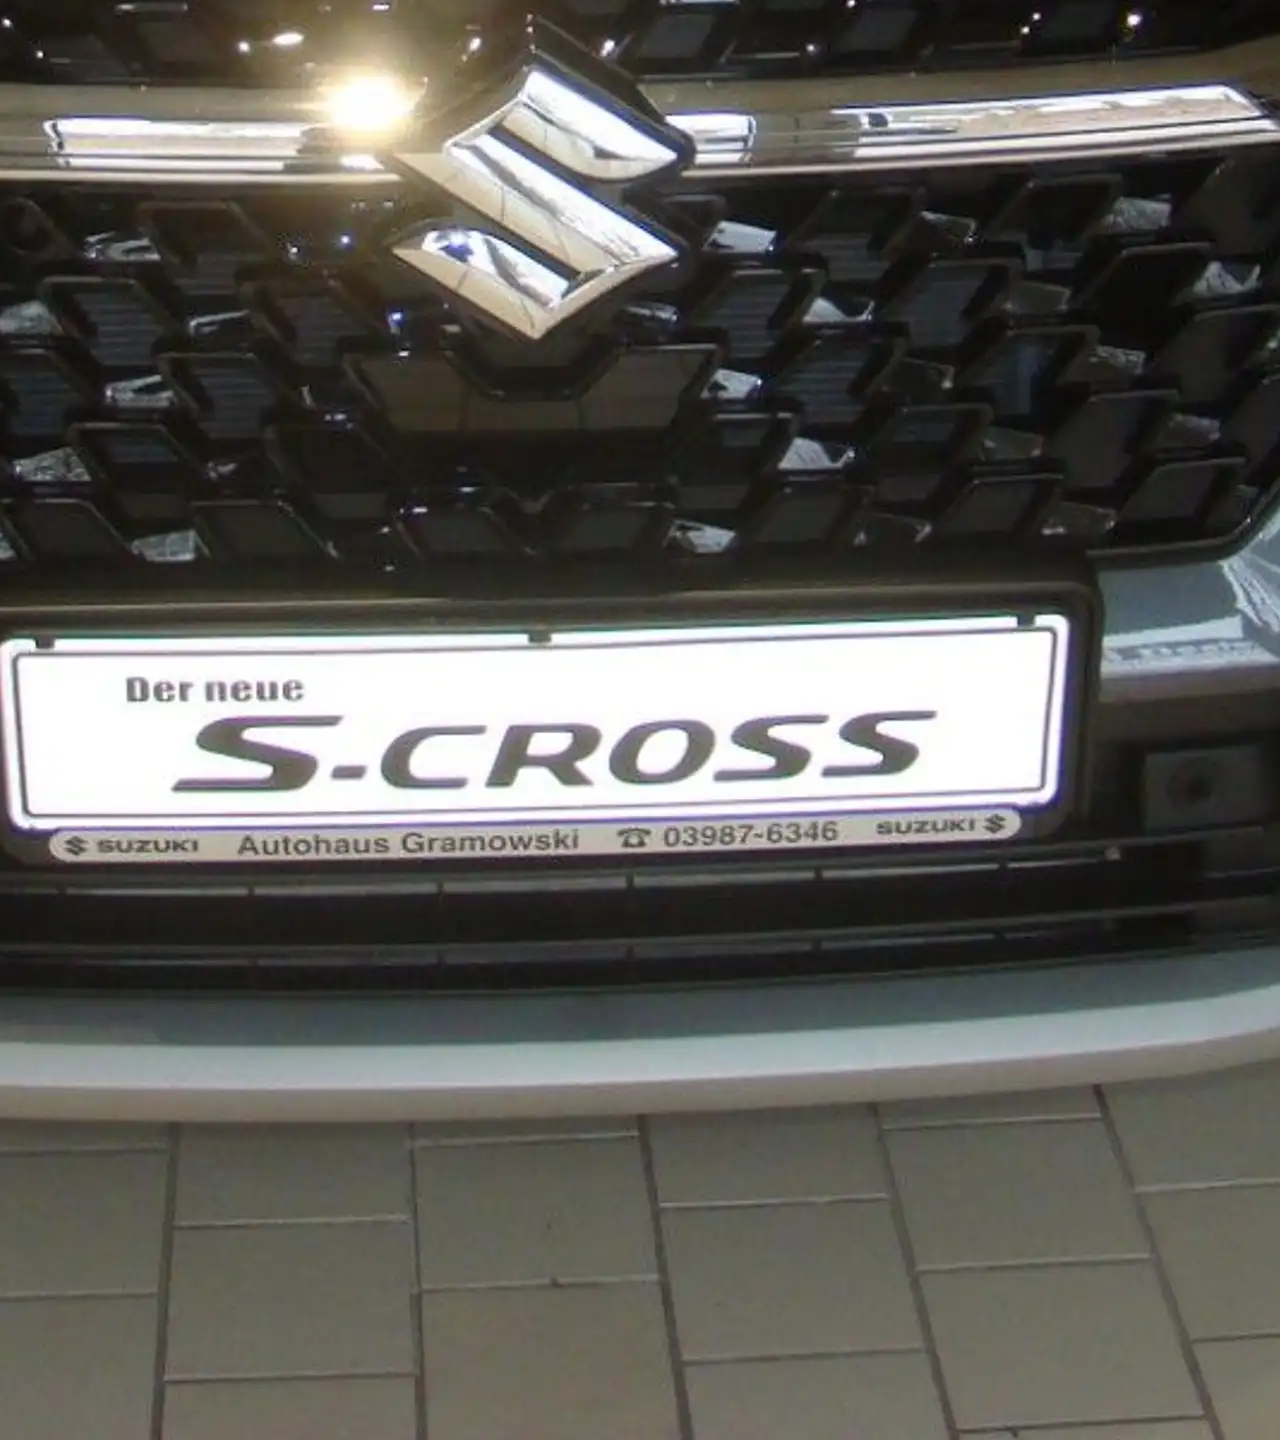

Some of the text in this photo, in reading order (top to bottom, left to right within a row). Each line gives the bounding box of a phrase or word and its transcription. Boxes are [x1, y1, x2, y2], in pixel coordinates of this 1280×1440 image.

[125, 676, 305, 703] Der neue
[171, 710, 937, 792] S-CROSS
[97, 817, 976, 857] SUZUKI Autohaus Gramowski 03987-6346 SUZUKI
